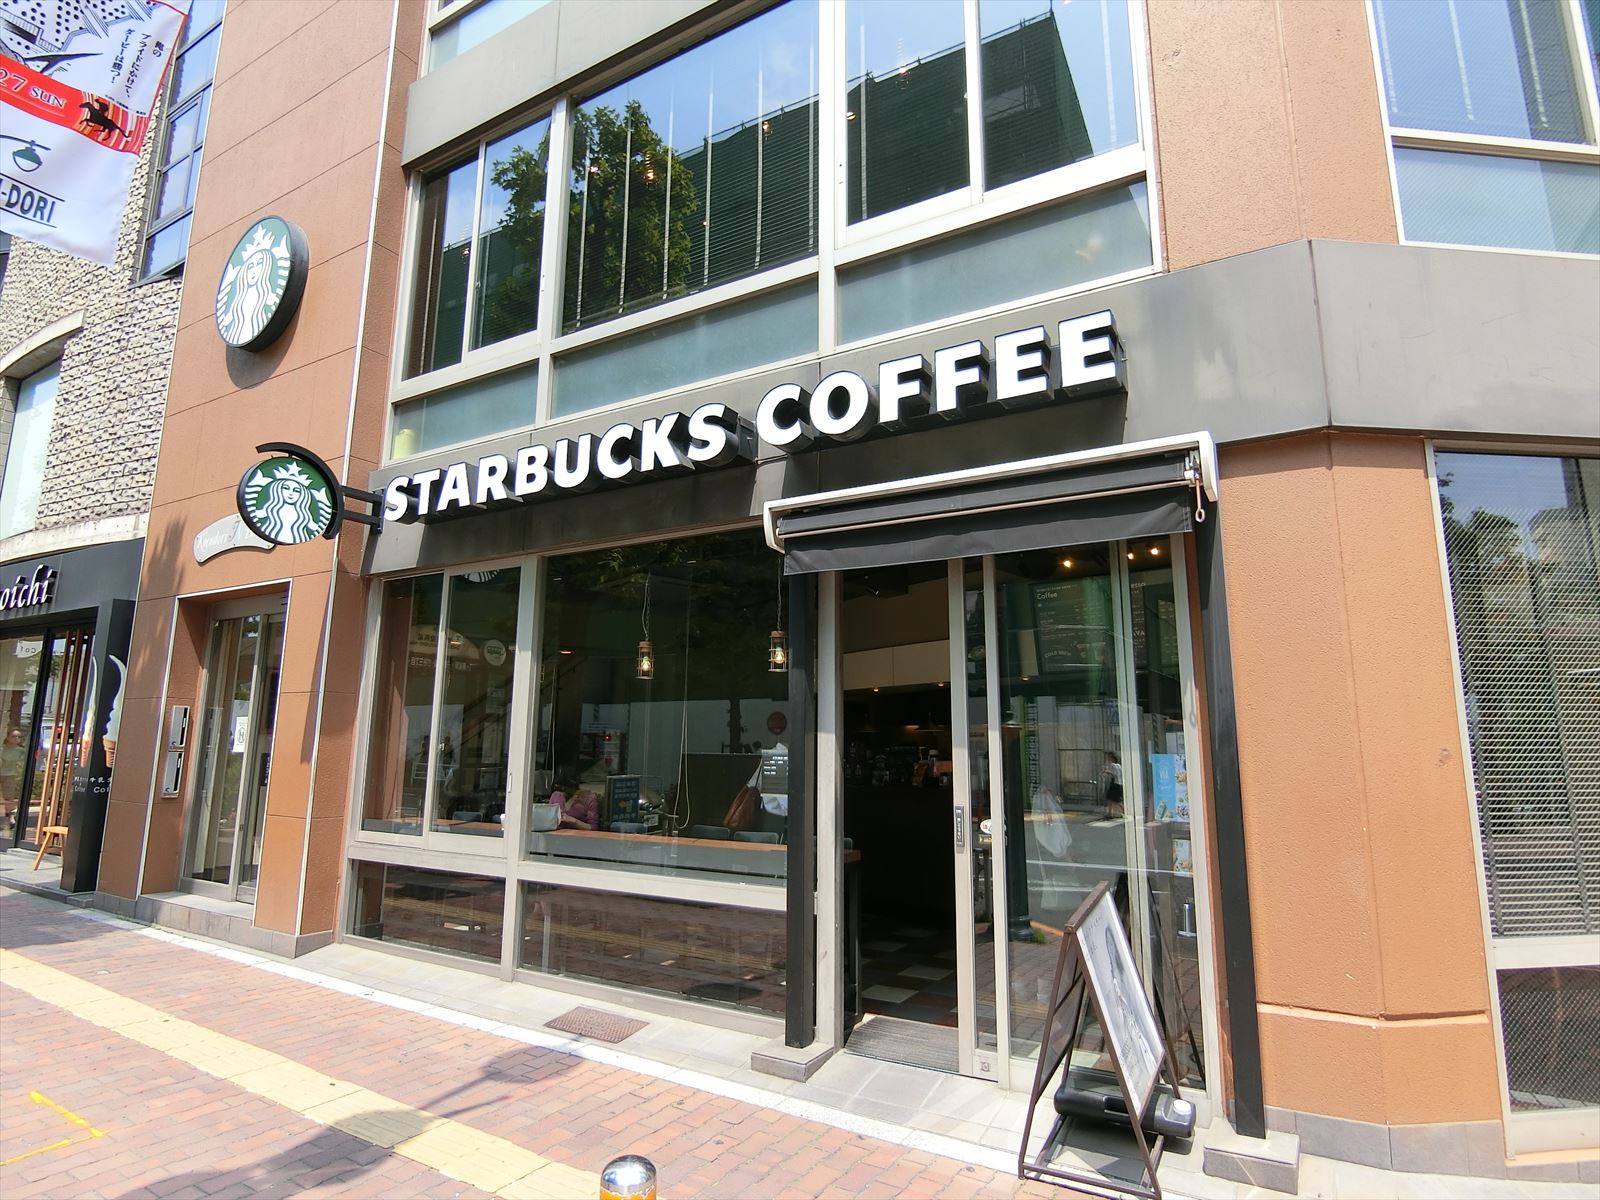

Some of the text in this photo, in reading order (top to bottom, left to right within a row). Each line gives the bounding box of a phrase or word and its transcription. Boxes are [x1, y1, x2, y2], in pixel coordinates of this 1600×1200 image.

[30, 86, 66, 108] SUN
[383, 309, 1119, 522] STARBUCKS COFFEE
[1036, 592, 1058, 600] Coffee
